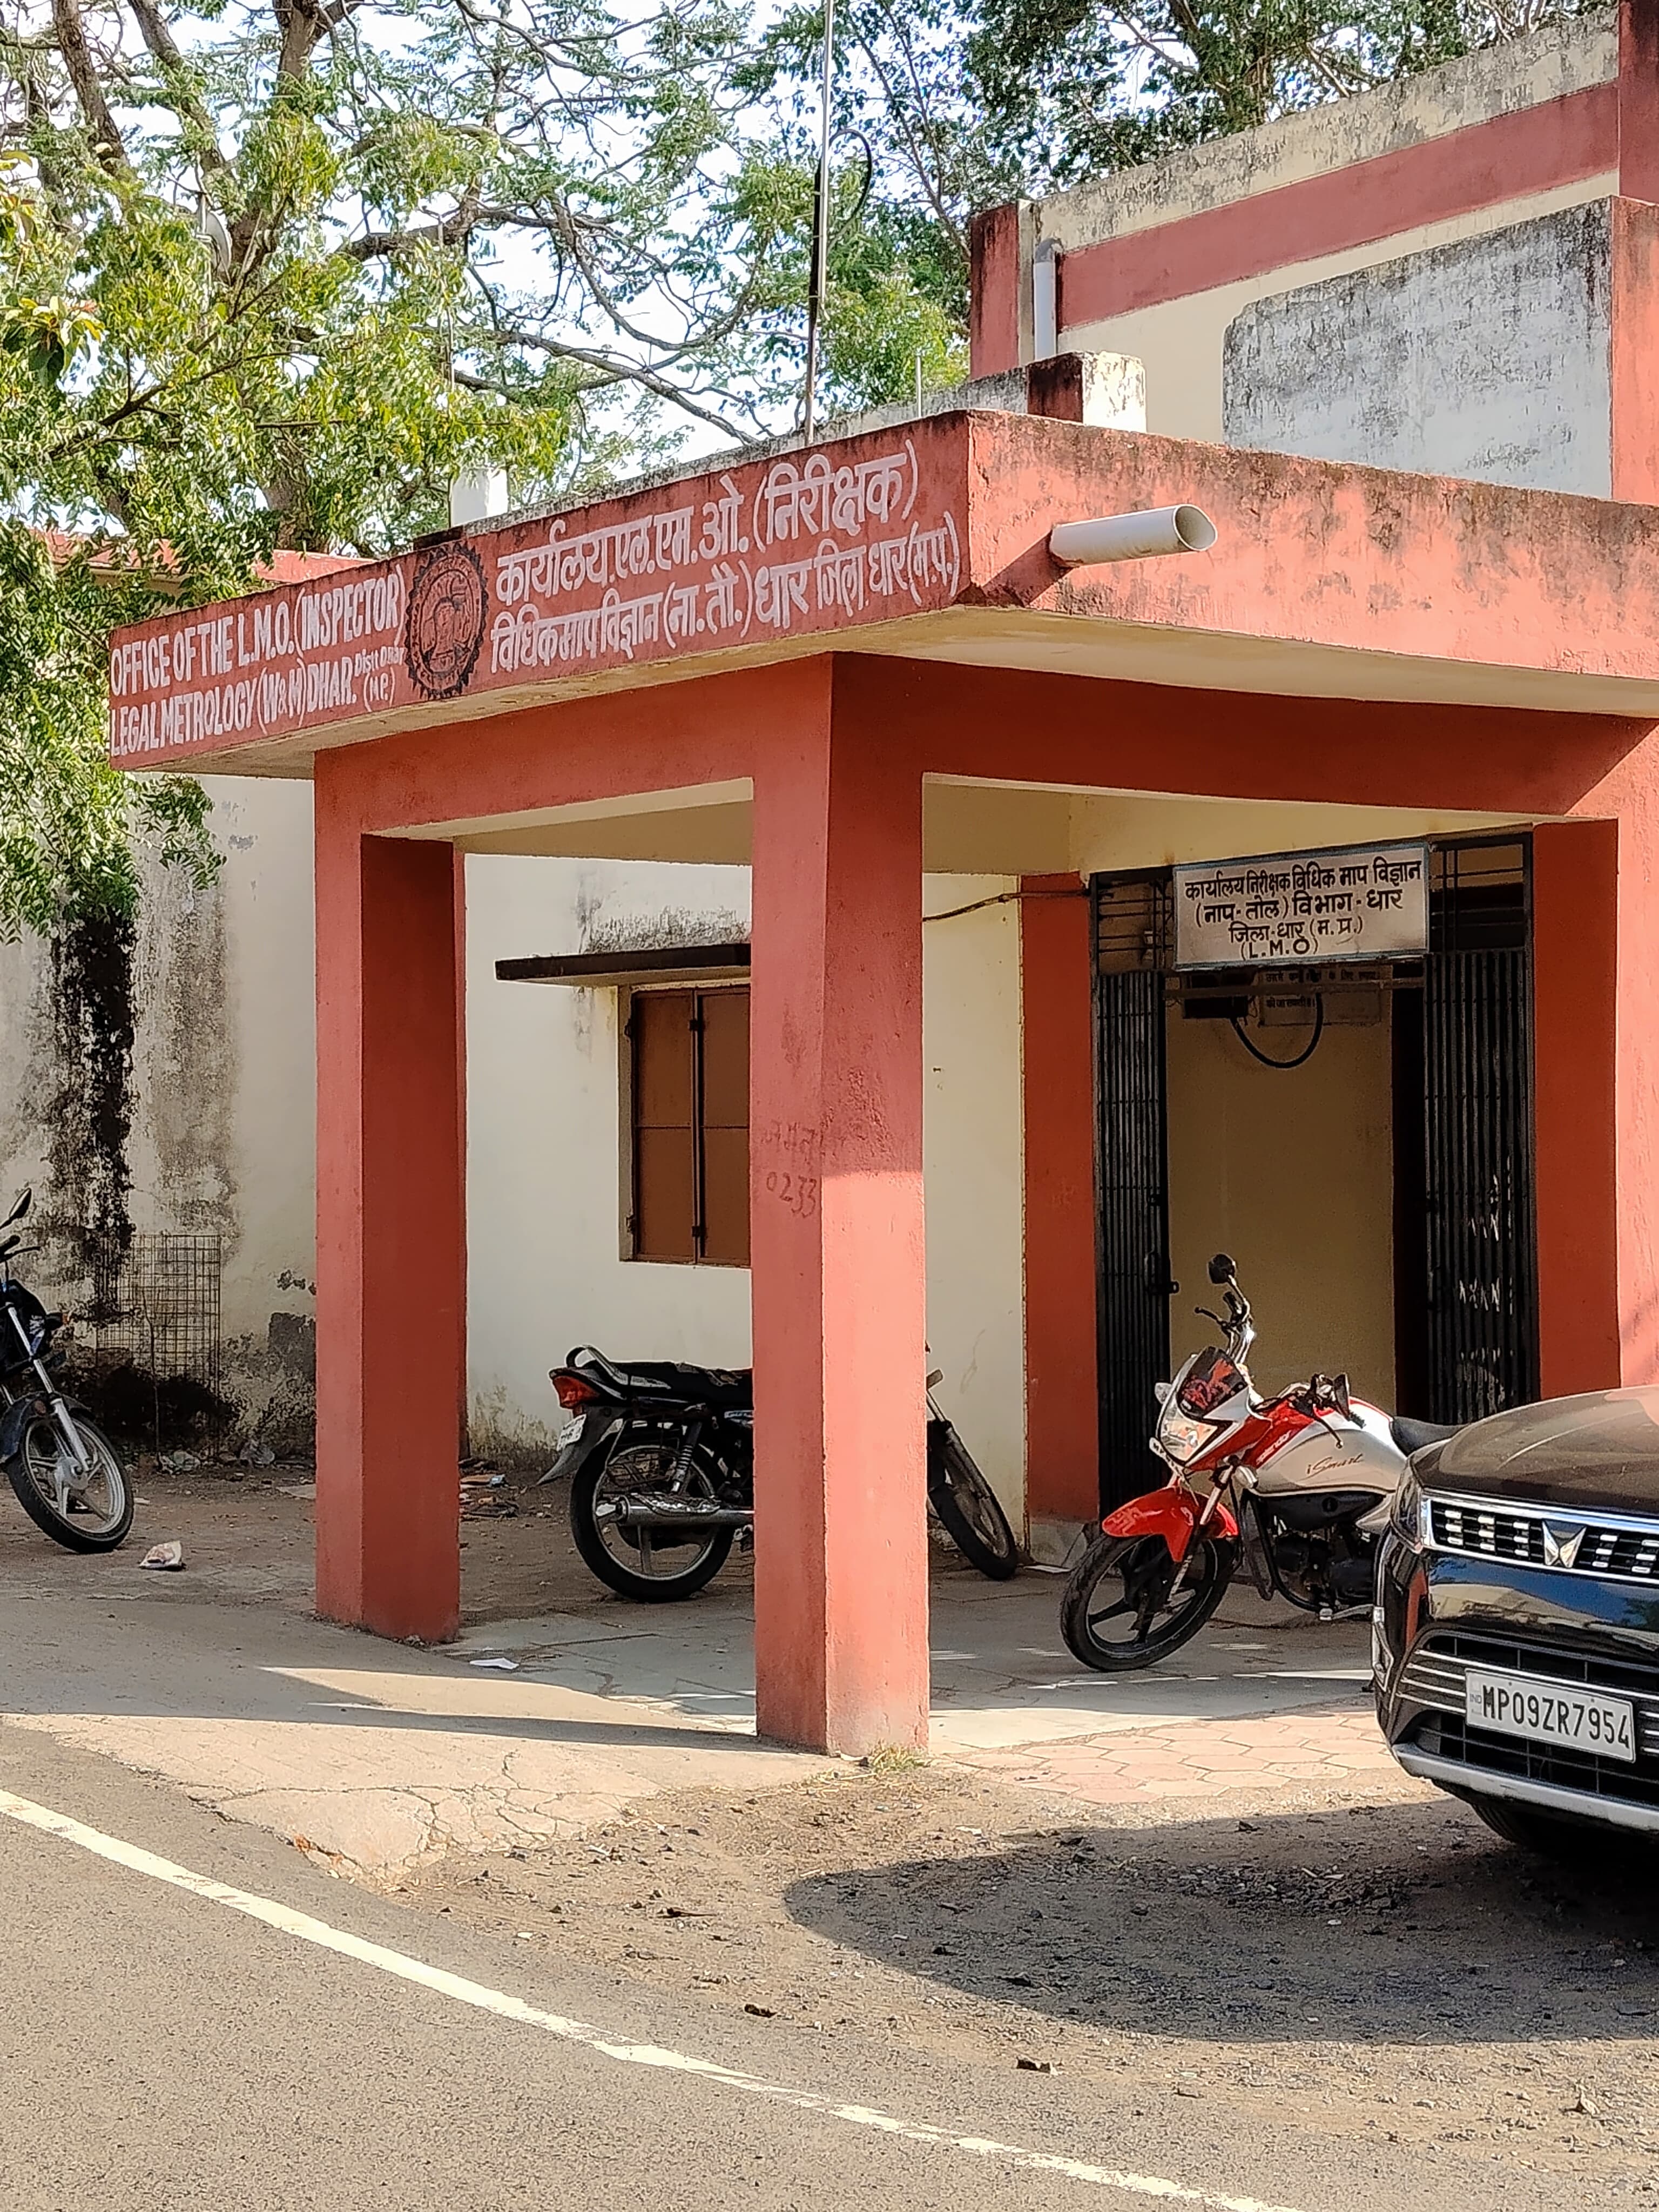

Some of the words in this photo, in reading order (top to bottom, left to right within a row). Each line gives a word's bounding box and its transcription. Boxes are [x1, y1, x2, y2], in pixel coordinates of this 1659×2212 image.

[753, 439, 918, 554] (निरीक्षक)
[754, 558, 812, 629] धार
[868, 537, 908, 596] धार
[111, 635, 170, 696] OFFICE
[173, 626, 196, 682] OF
[197, 616, 233, 677] THE
[238, 601, 294, 666] L.M.O.
[294, 564, 405, 658] (INSPECTOR)
[111, 702, 159, 757] LEGAL
[160, 677, 257, 748] METROLOGY
[1185, 870, 1245, 901] कार्यालय
[1246, 869, 1291, 897] निरीक्षक
[1292, 861, 1336, 890] विधिक
[1339, 865, 1368, 886] माप
[1373, 856, 1422, 887] विज्ञान
[1291, 890, 1353, 915] विभाग
[1366, 889, 1403, 912] धार
[1469, 1694, 1482, 1704] IND
[1483, 1684, 1630, 1749] MP09ZR7954
